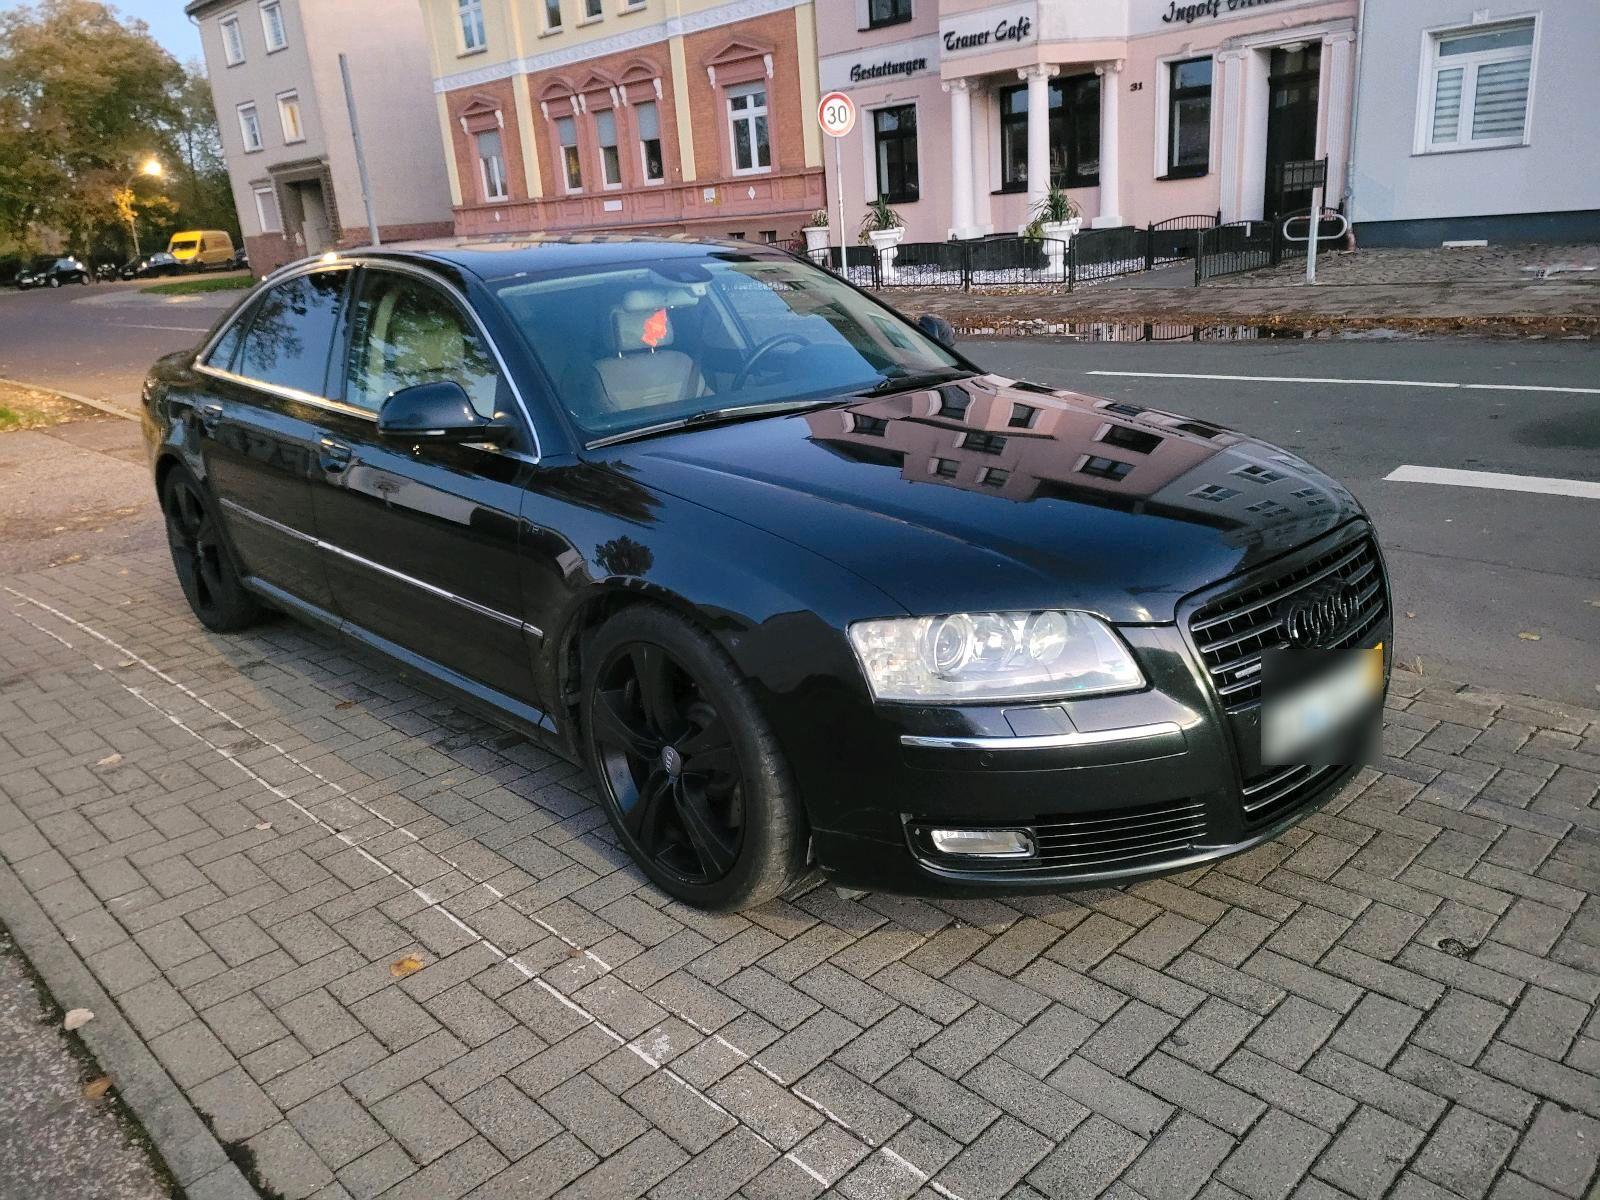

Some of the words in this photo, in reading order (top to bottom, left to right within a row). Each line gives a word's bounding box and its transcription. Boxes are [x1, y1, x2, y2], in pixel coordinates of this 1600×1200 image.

[944, 30, 990, 51] Trauer
[850, 58, 927, 82] Bestattungen
[1130, 81, 1143, 92] 31
[827, 105, 847, 125] 30
